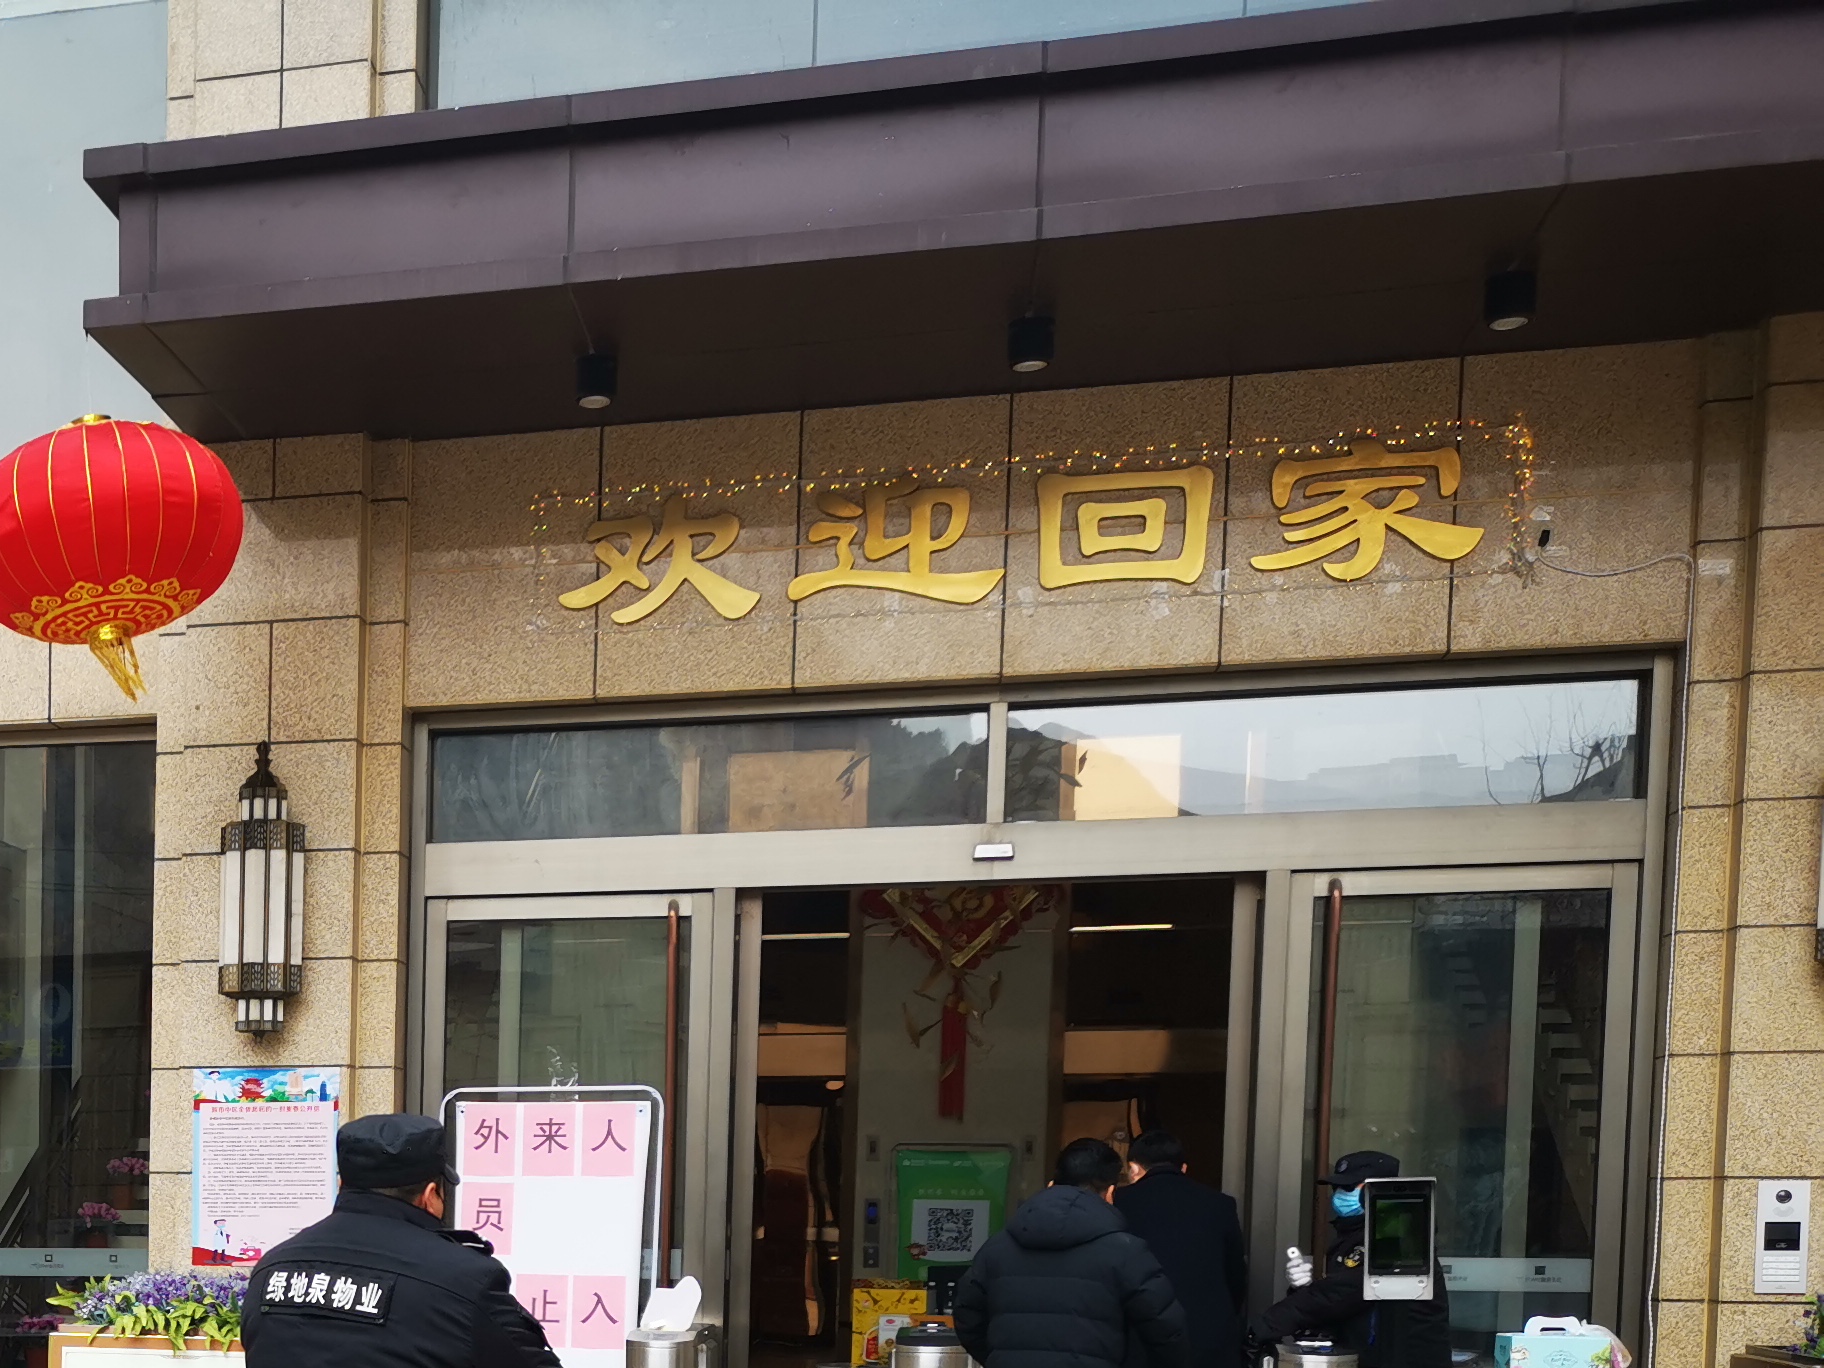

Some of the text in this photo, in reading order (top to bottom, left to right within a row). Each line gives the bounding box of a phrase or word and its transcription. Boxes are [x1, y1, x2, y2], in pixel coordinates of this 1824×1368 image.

[559, 441, 1485, 624] 欢迎回家
[473, 1117, 628, 1154] 外来人
[472, 1197, 504, 1232] 员
[265, 1271, 383, 1314] 绿地泉物业
